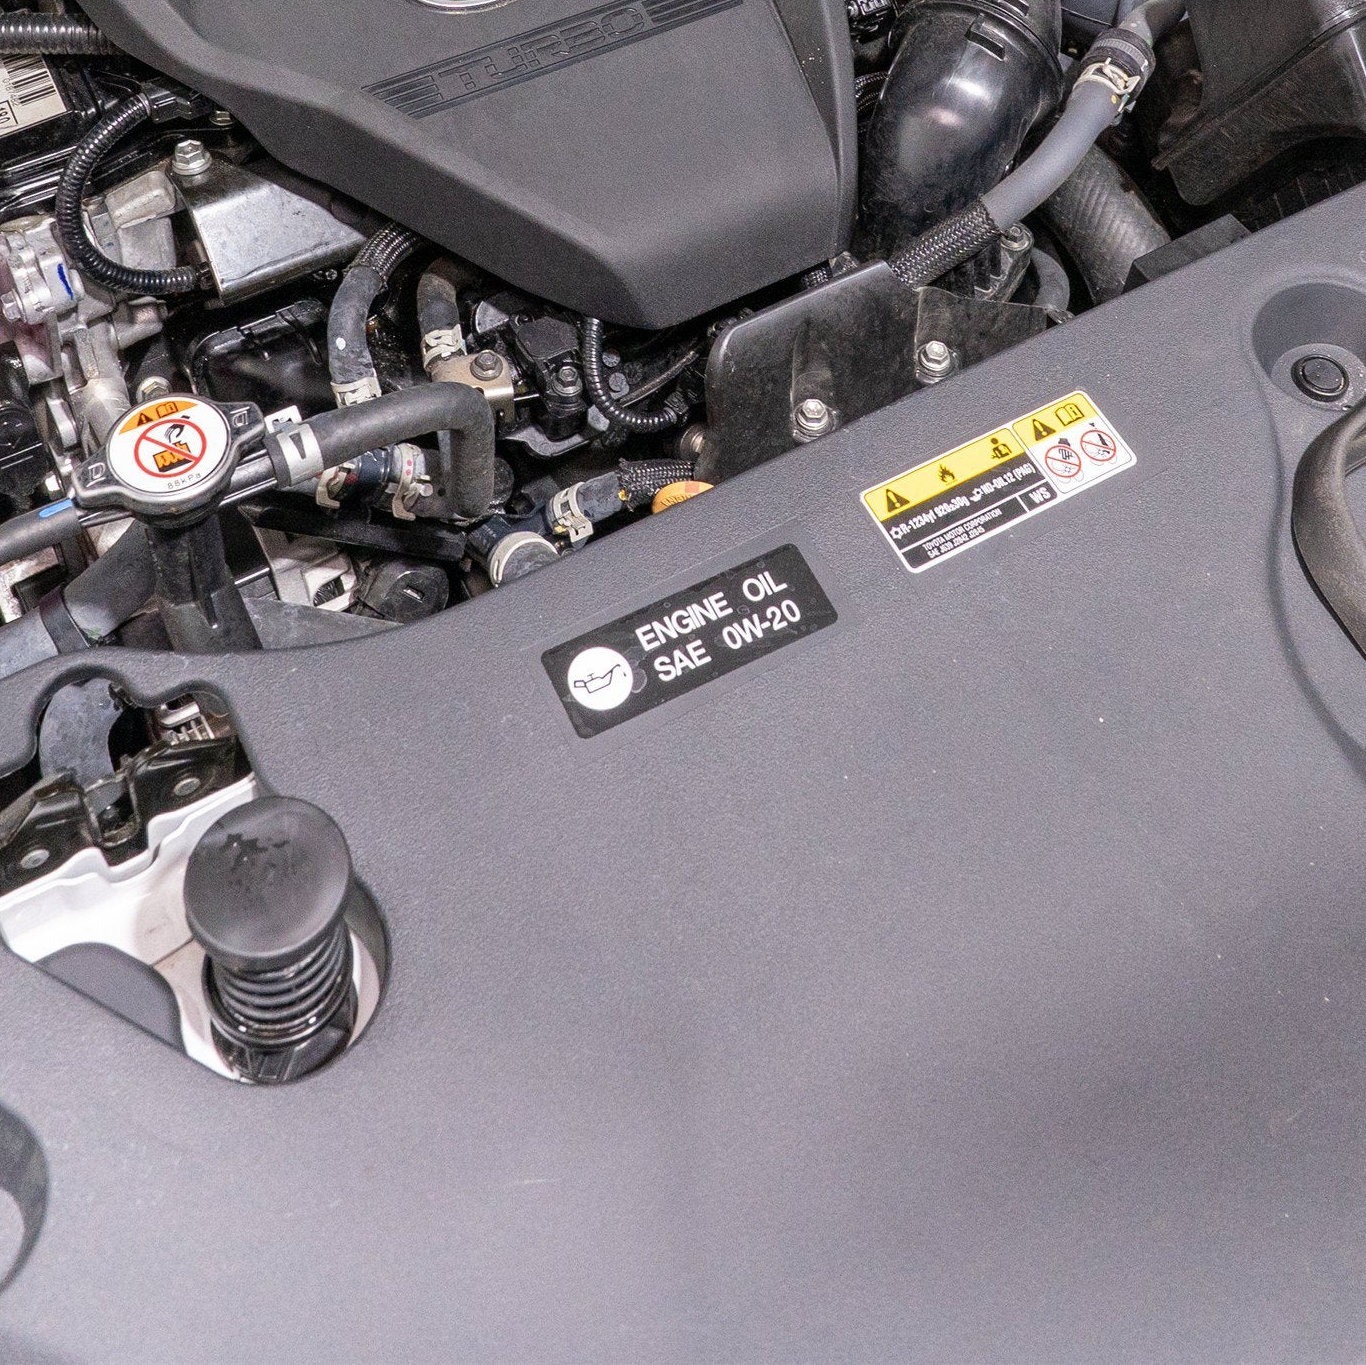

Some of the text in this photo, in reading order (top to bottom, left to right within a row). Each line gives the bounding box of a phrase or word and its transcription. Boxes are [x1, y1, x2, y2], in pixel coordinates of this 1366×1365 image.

[439, 6, 646, 91] TURBO
[167, 472, 202, 490] 88kPa
[1029, 486, 1052, 505] WS
[922, 507, 1003, 552] TOYOTA MOTOR CORPORATION
[927, 547, 940, 560] SAE
[635, 570, 788, 652] ENGINE OIL
[653, 599, 802, 682] SAE 0W-20
